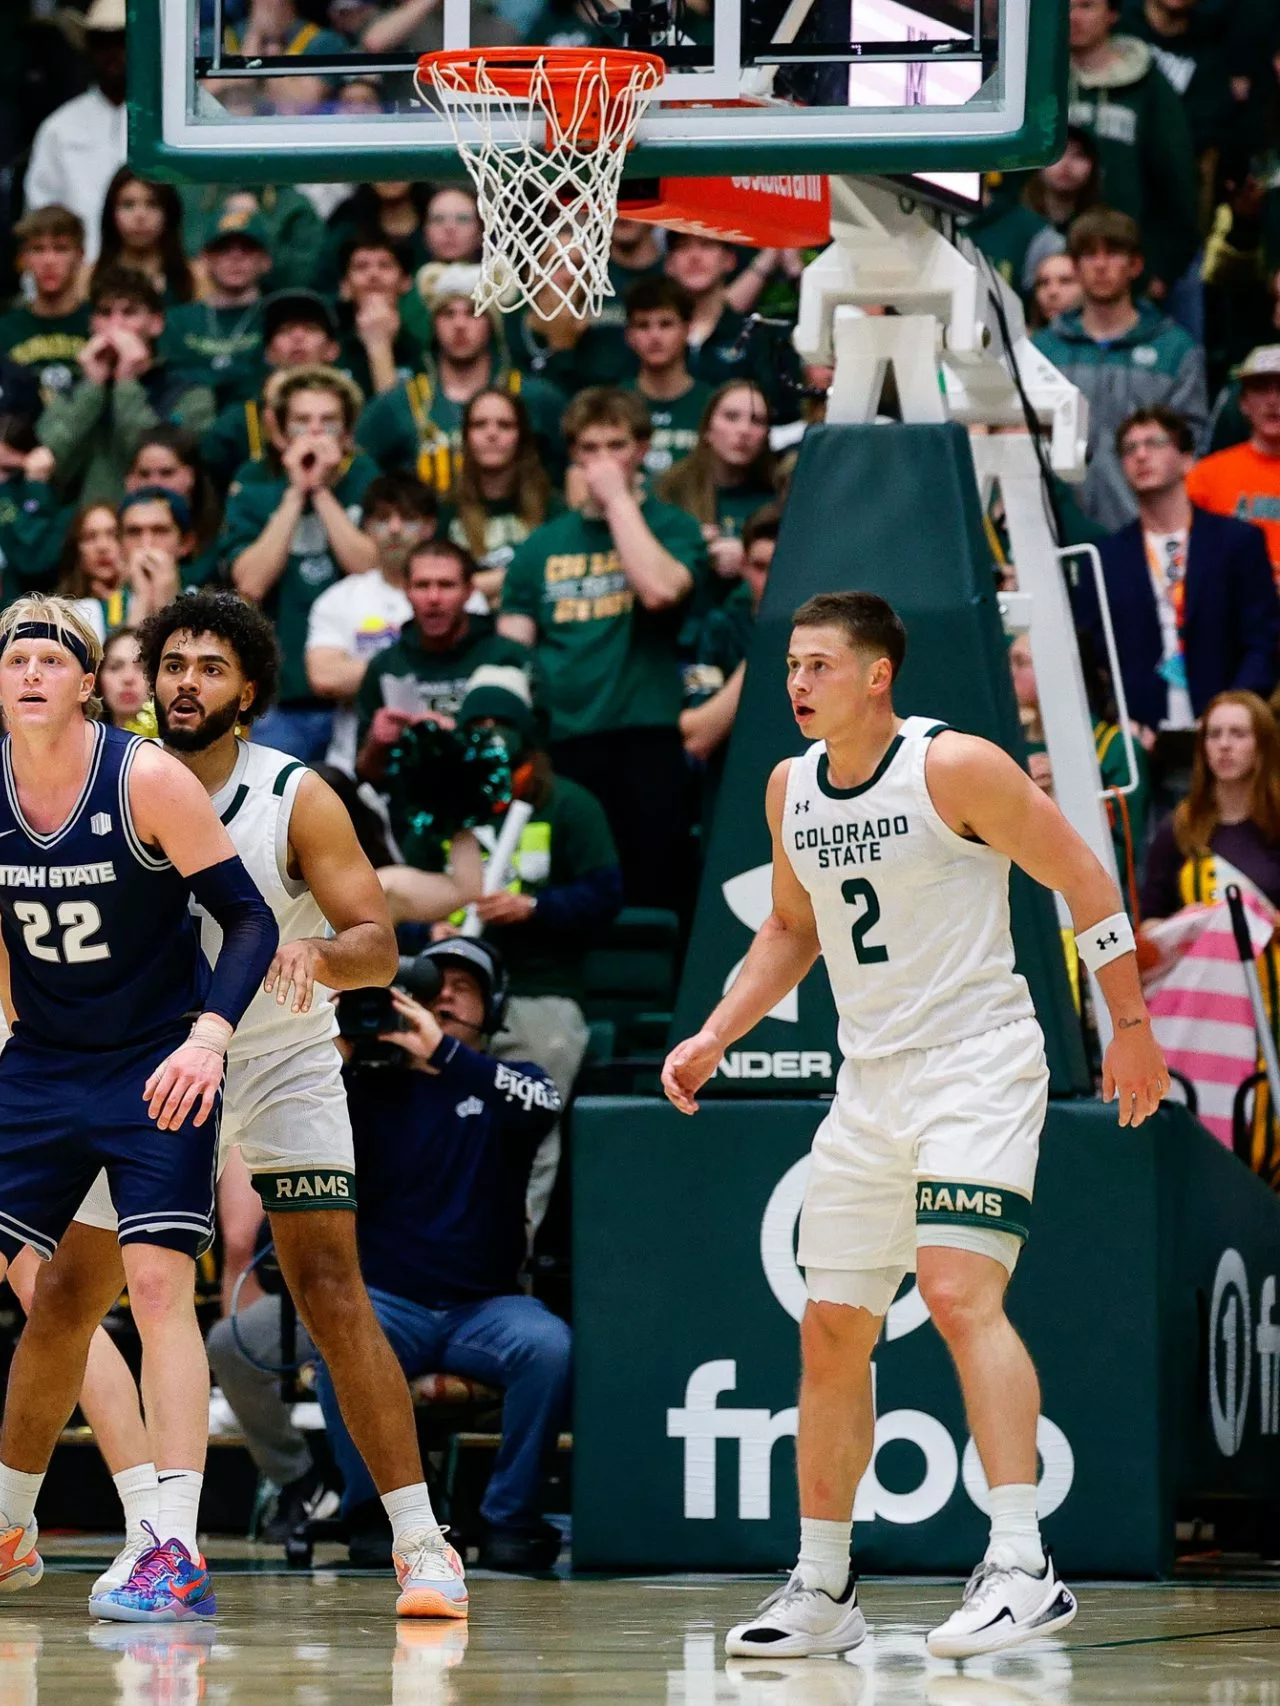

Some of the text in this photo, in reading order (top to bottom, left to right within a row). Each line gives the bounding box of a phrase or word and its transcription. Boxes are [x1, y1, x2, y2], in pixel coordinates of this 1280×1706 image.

[794, 815, 909, 851] COLORADO
[818, 842, 882, 869] STATE
[48, 860, 117, 889] STATE
[12, 900, 112, 964] 22
[841, 877, 889, 965] 2
[710, 1051, 832, 1078] NDER
[276, 1175, 349, 1198] RAMS
[920, 1187, 1002, 1217] RAMS
